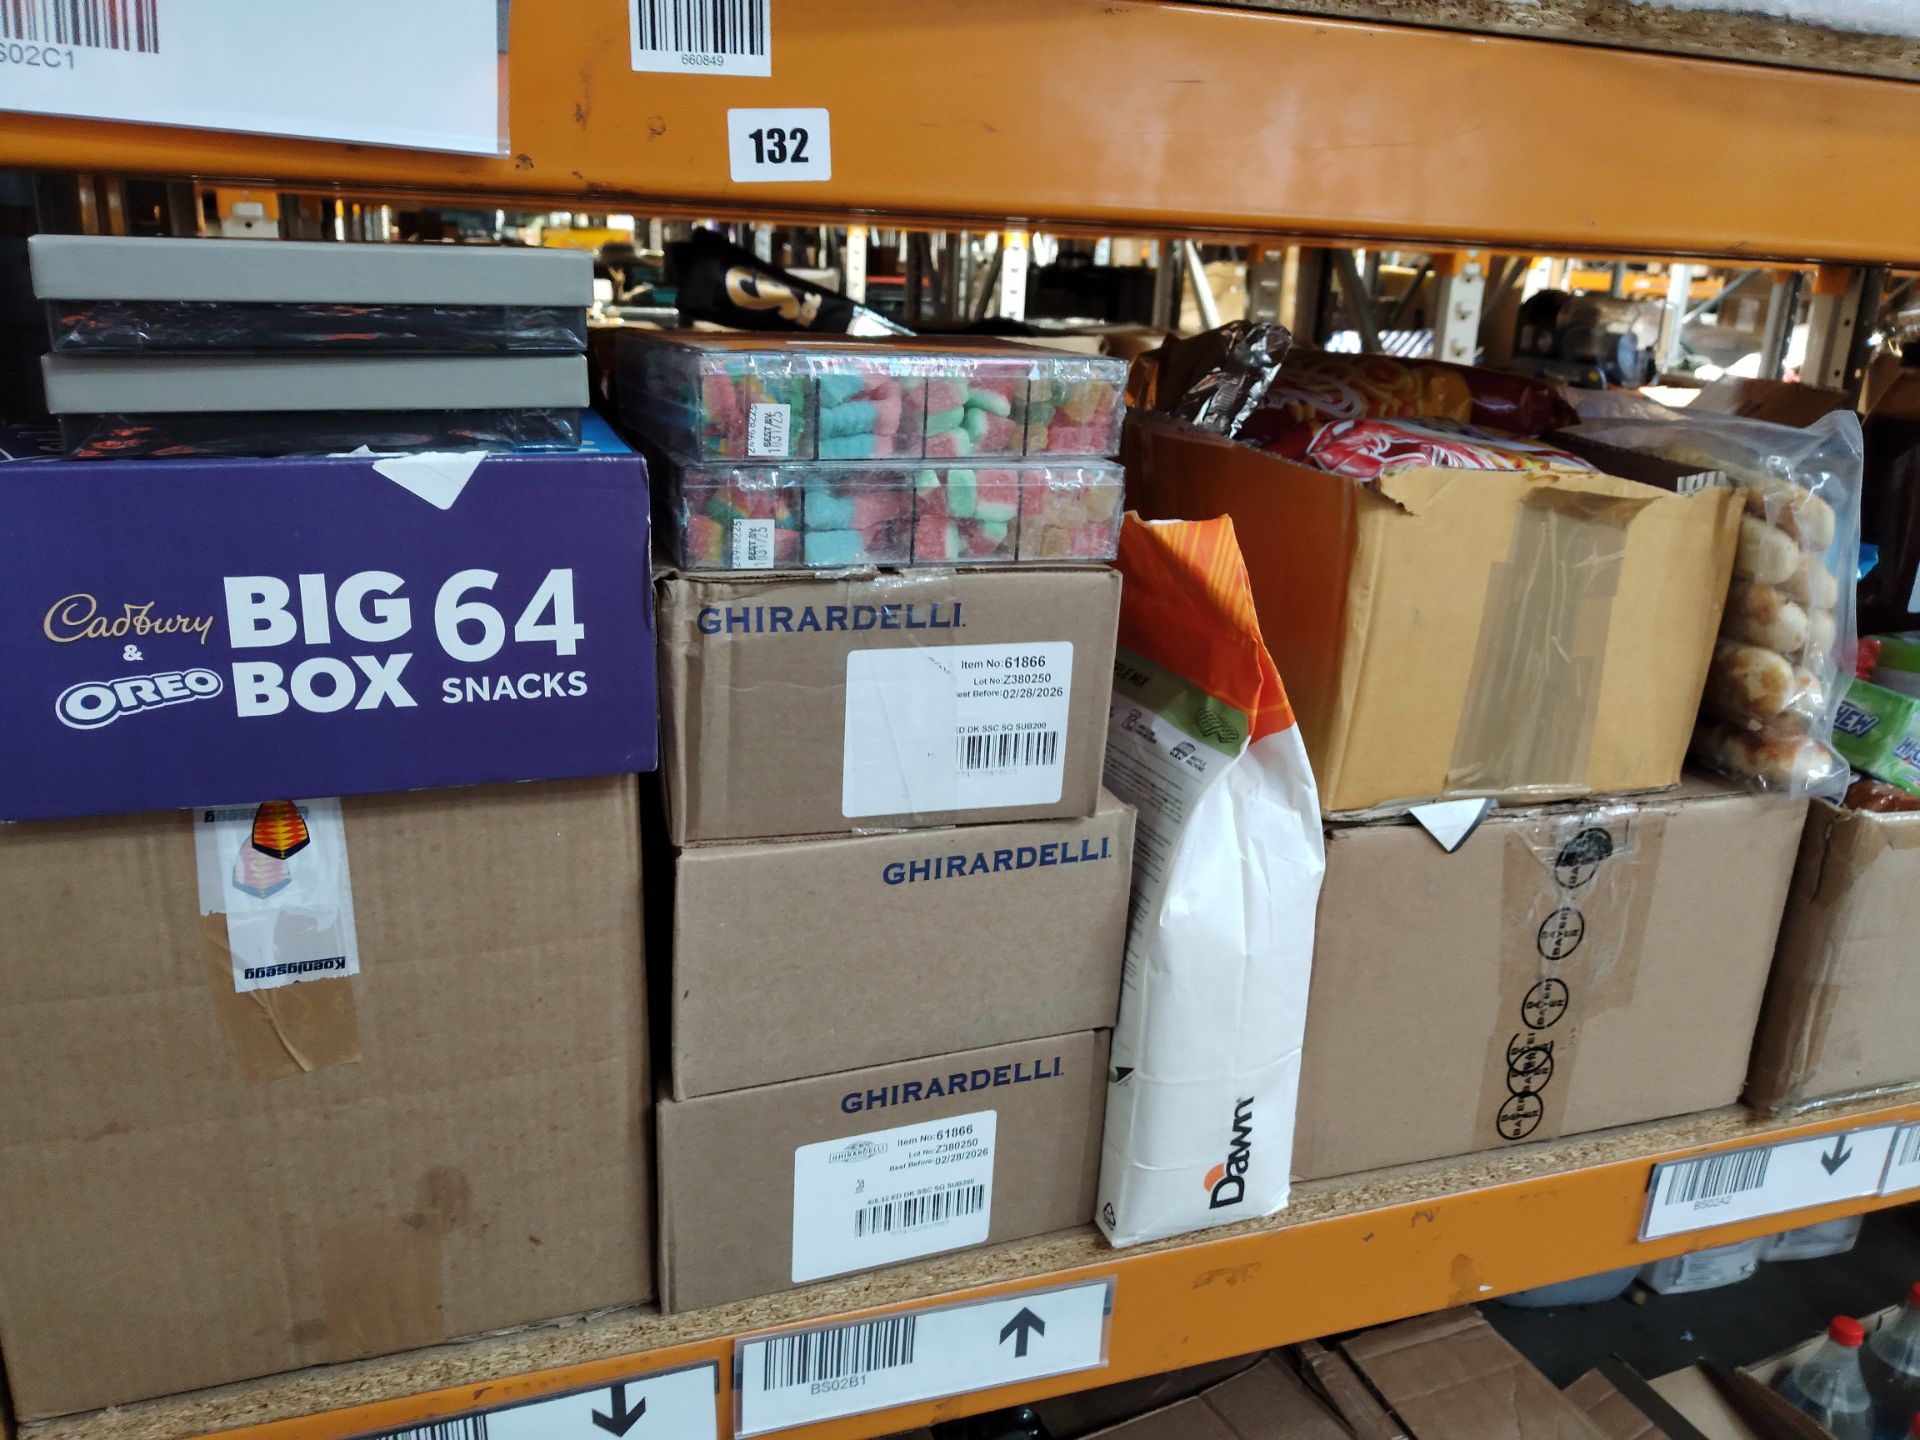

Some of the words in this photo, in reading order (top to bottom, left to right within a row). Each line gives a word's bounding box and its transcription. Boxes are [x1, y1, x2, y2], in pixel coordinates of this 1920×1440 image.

[681, 54, 725, 67] 660849
[749, 127, 809, 164] 132
[763, 426, 772, 448] BEST
[748, 540, 756, 561] BEST
[43, 593, 214, 645] Cadbury
[223, 570, 412, 648] BIG
[434, 568, 585, 663] 64
[122, 644, 143, 662] &
[961, 660, 983, 670] Item
[231, 653, 418, 718] BOX
[442, 671, 588, 704] SNACKS
[973, 678, 987, 686] Lot
[64, 669, 219, 721] OREO
[956, 691, 970, 699] est
[982, 724, 999, 732] SSC
[1001, 723, 1013, 731] SQ
[244, 956, 346, 980] Koenigsegg
[897, 1137, 918, 1148] Item
[1208, 1096, 1255, 1210] Dawn
[908, 1149, 921, 1159] Lot
[889, 1163, 907, 1173] Best
[810, 1374, 866, 1396] BS02B1
